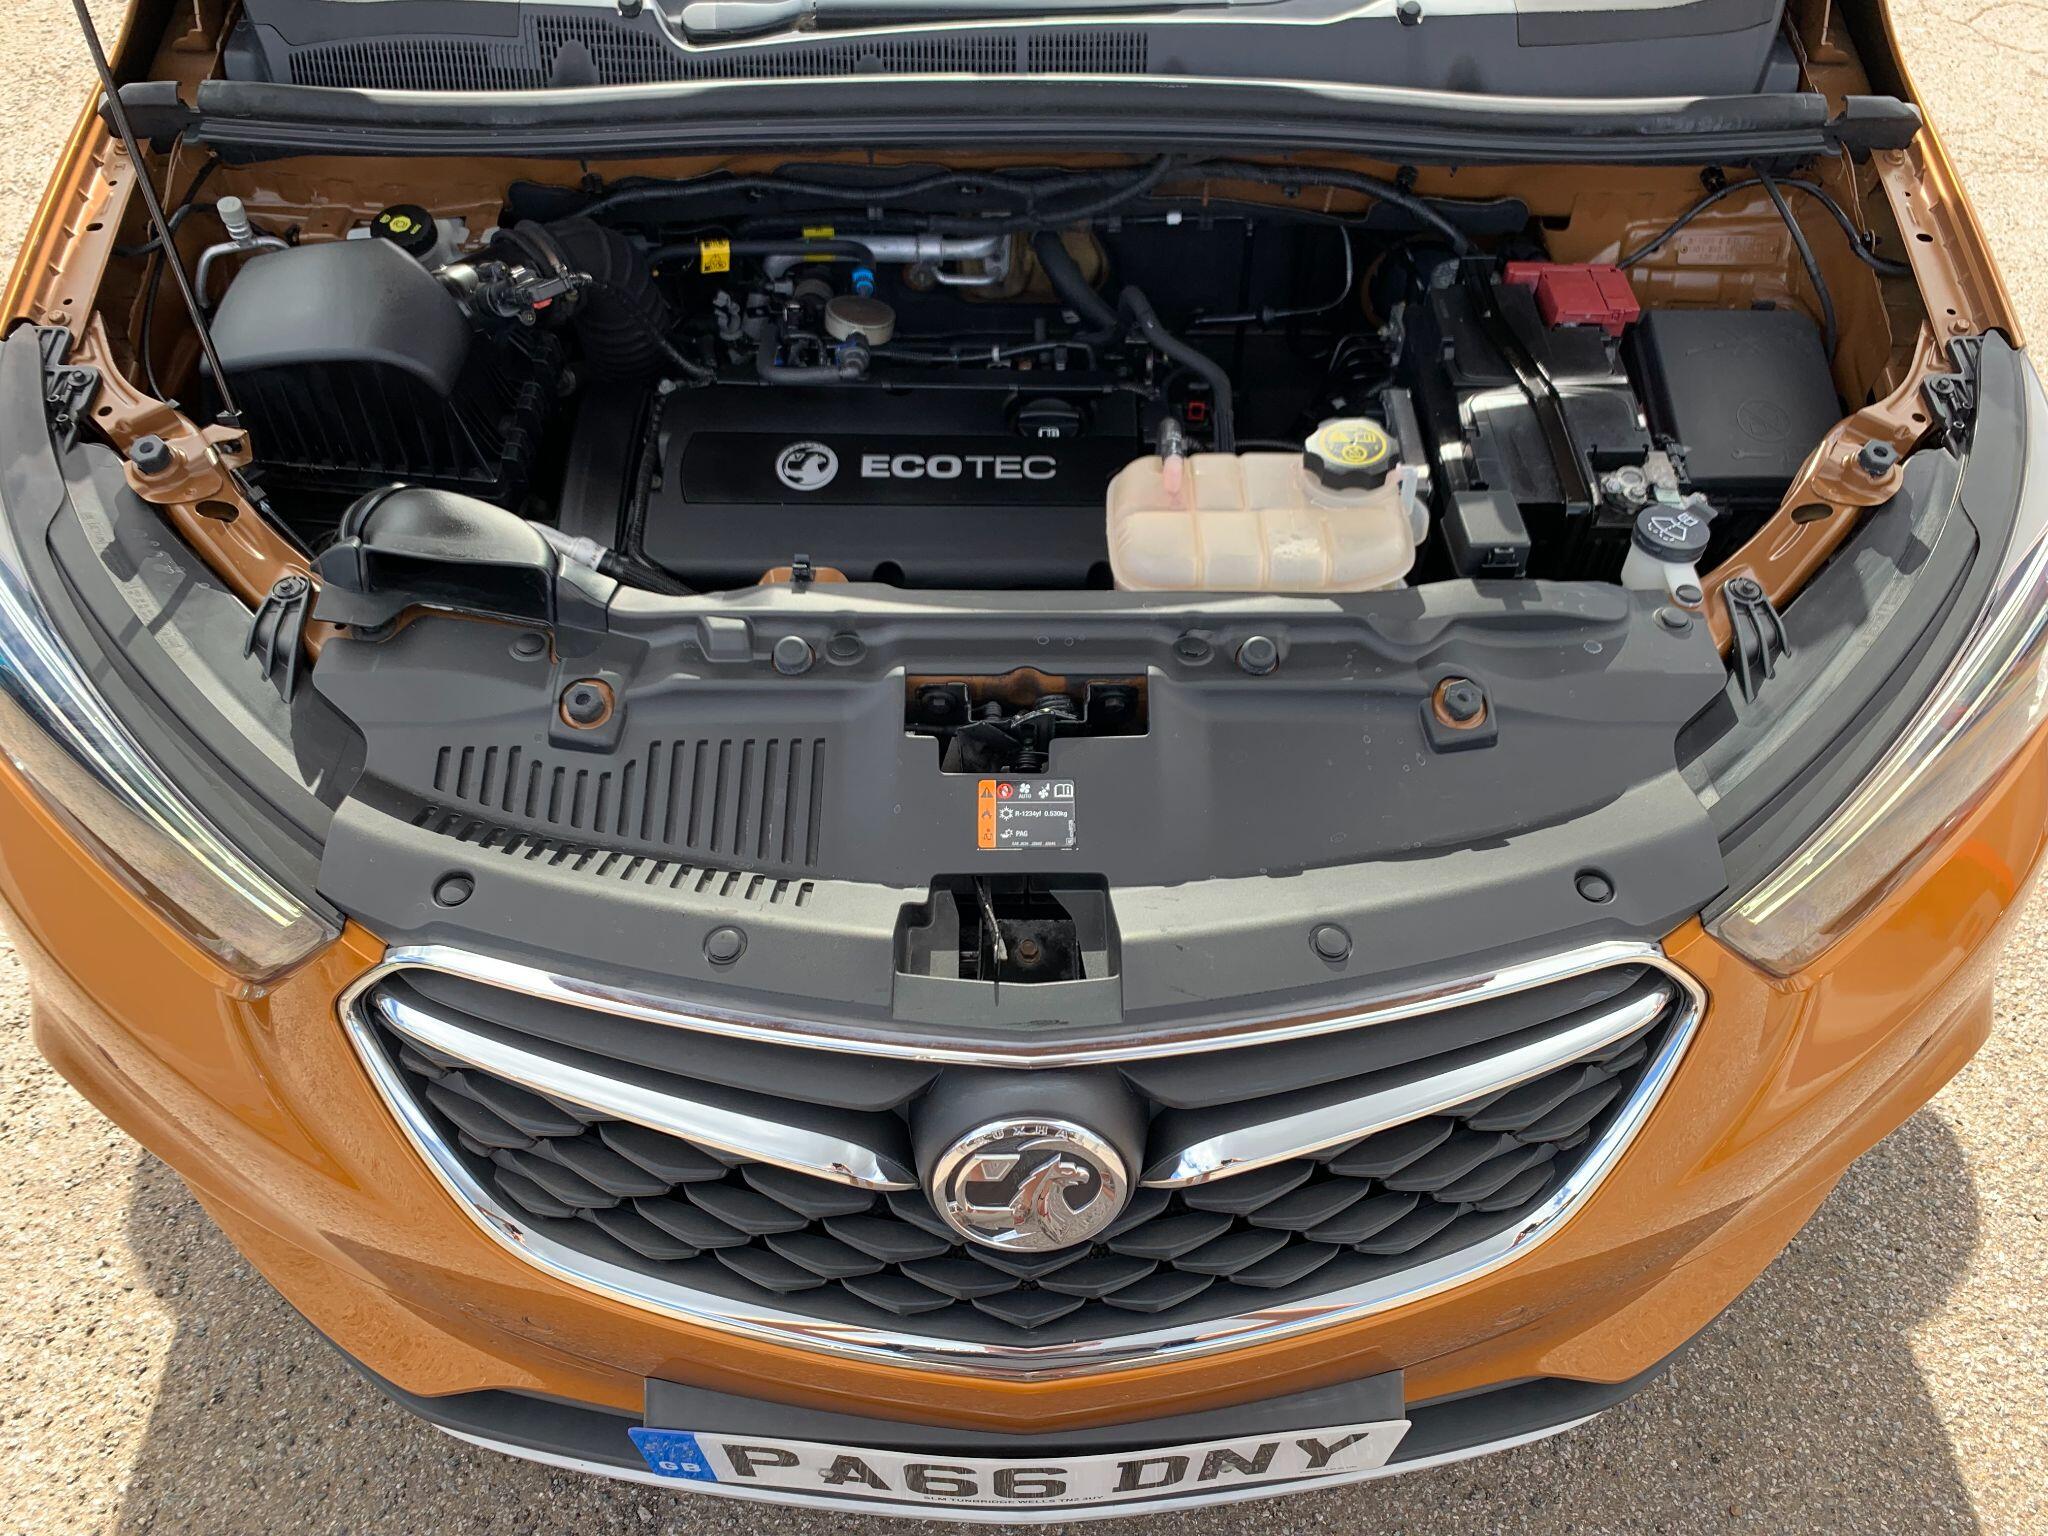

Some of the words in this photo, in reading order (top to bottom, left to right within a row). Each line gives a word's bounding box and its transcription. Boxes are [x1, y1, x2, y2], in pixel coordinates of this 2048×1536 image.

[861, 454, 1057, 479] ECOTEC
[658, 1461, 702, 1472] GB
[721, 1443, 1068, 1499] PA66
[1111, 1432, 1369, 1493] DNY
[950, 1497, 1015, 1505] TUNBRIDGE
